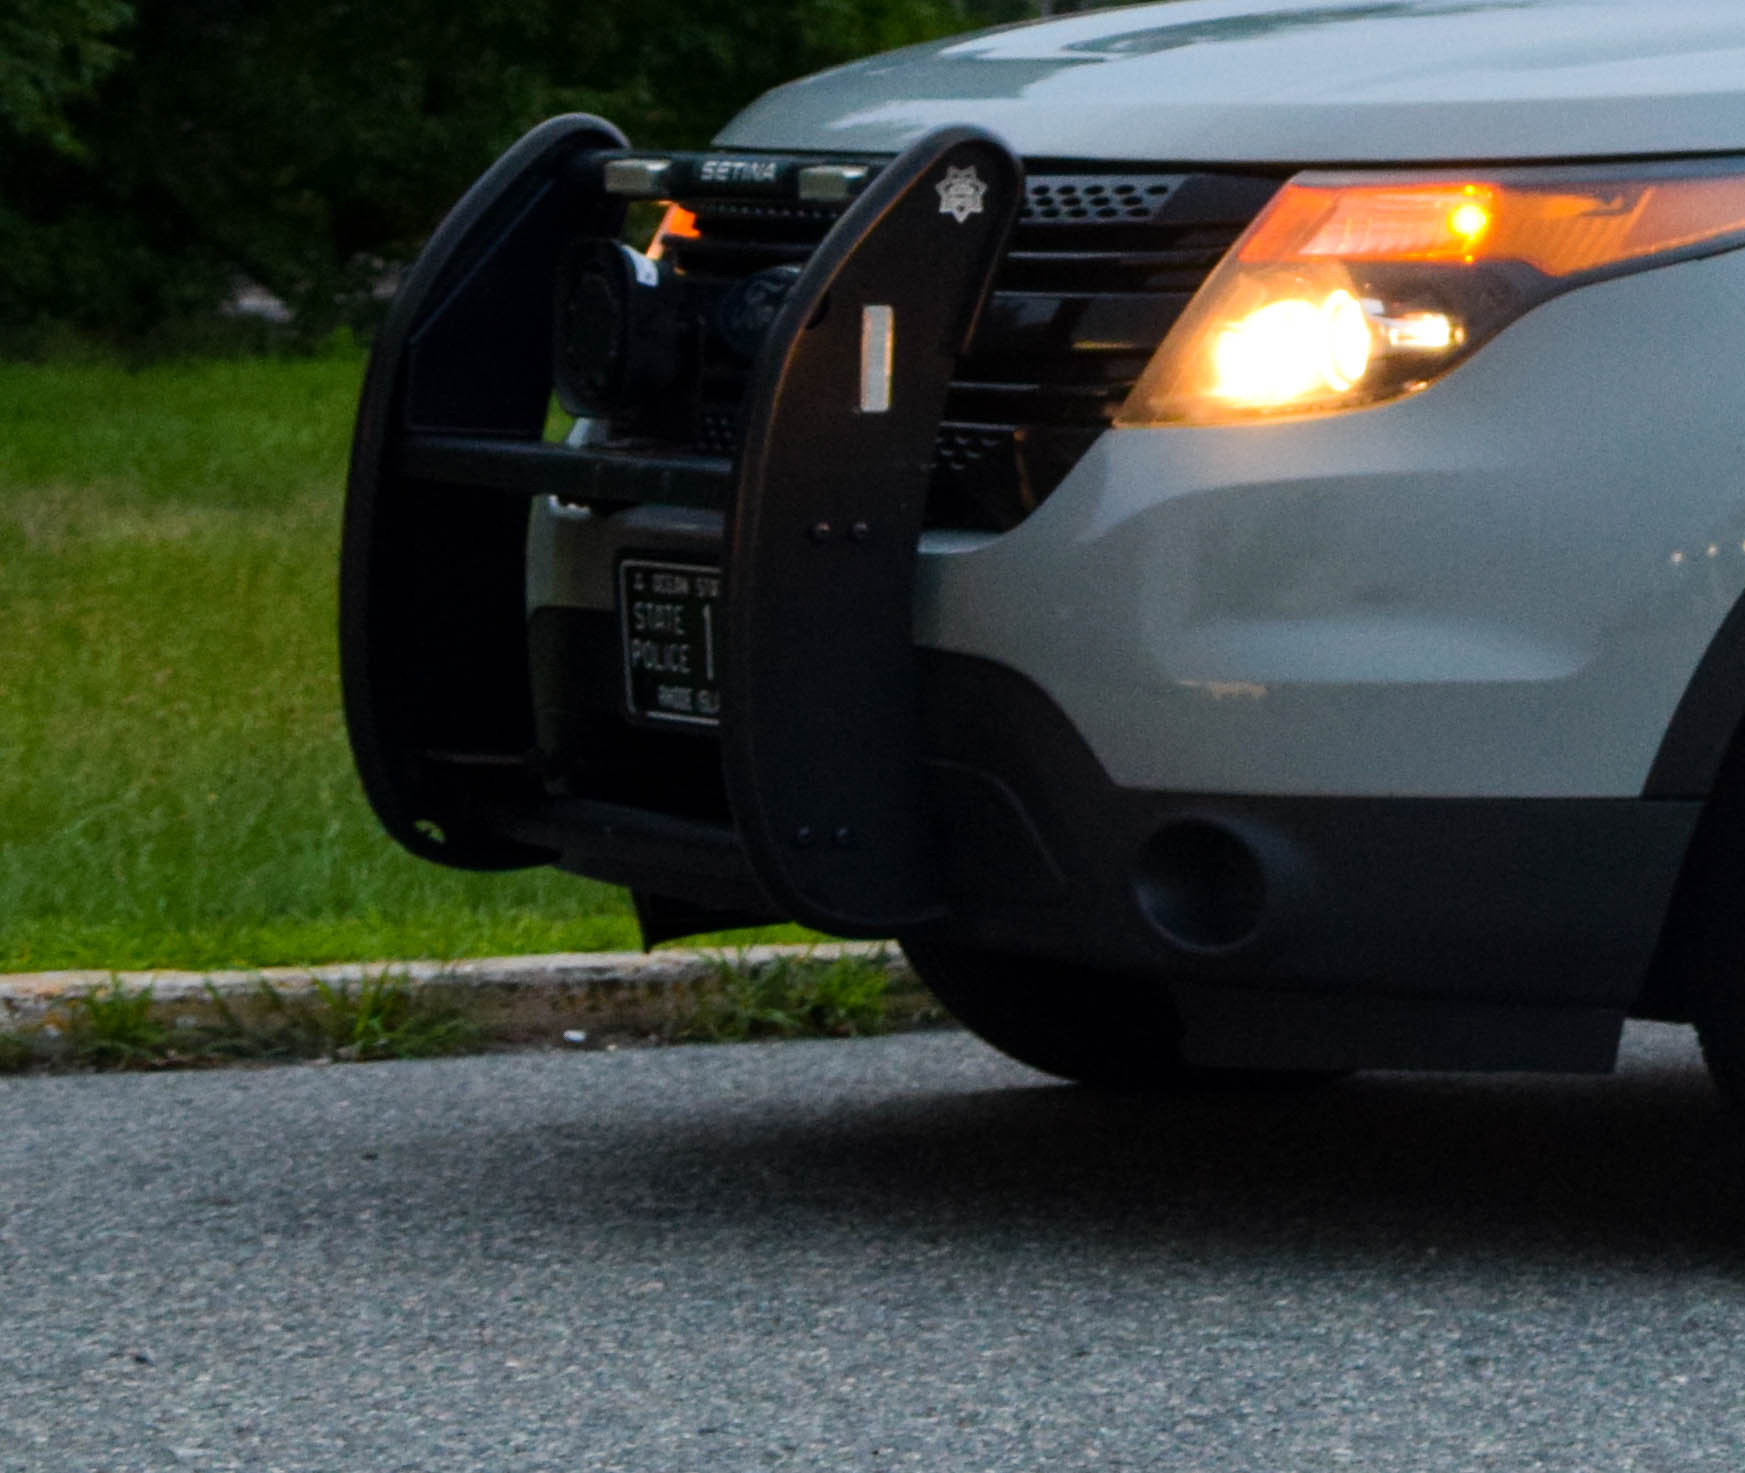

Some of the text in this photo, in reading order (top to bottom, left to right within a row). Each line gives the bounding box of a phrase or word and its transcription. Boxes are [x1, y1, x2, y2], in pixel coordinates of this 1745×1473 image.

[699, 160, 778, 183] SETINA
[633, 600, 686, 636] STATE
[631, 637, 692, 675] POLICE
